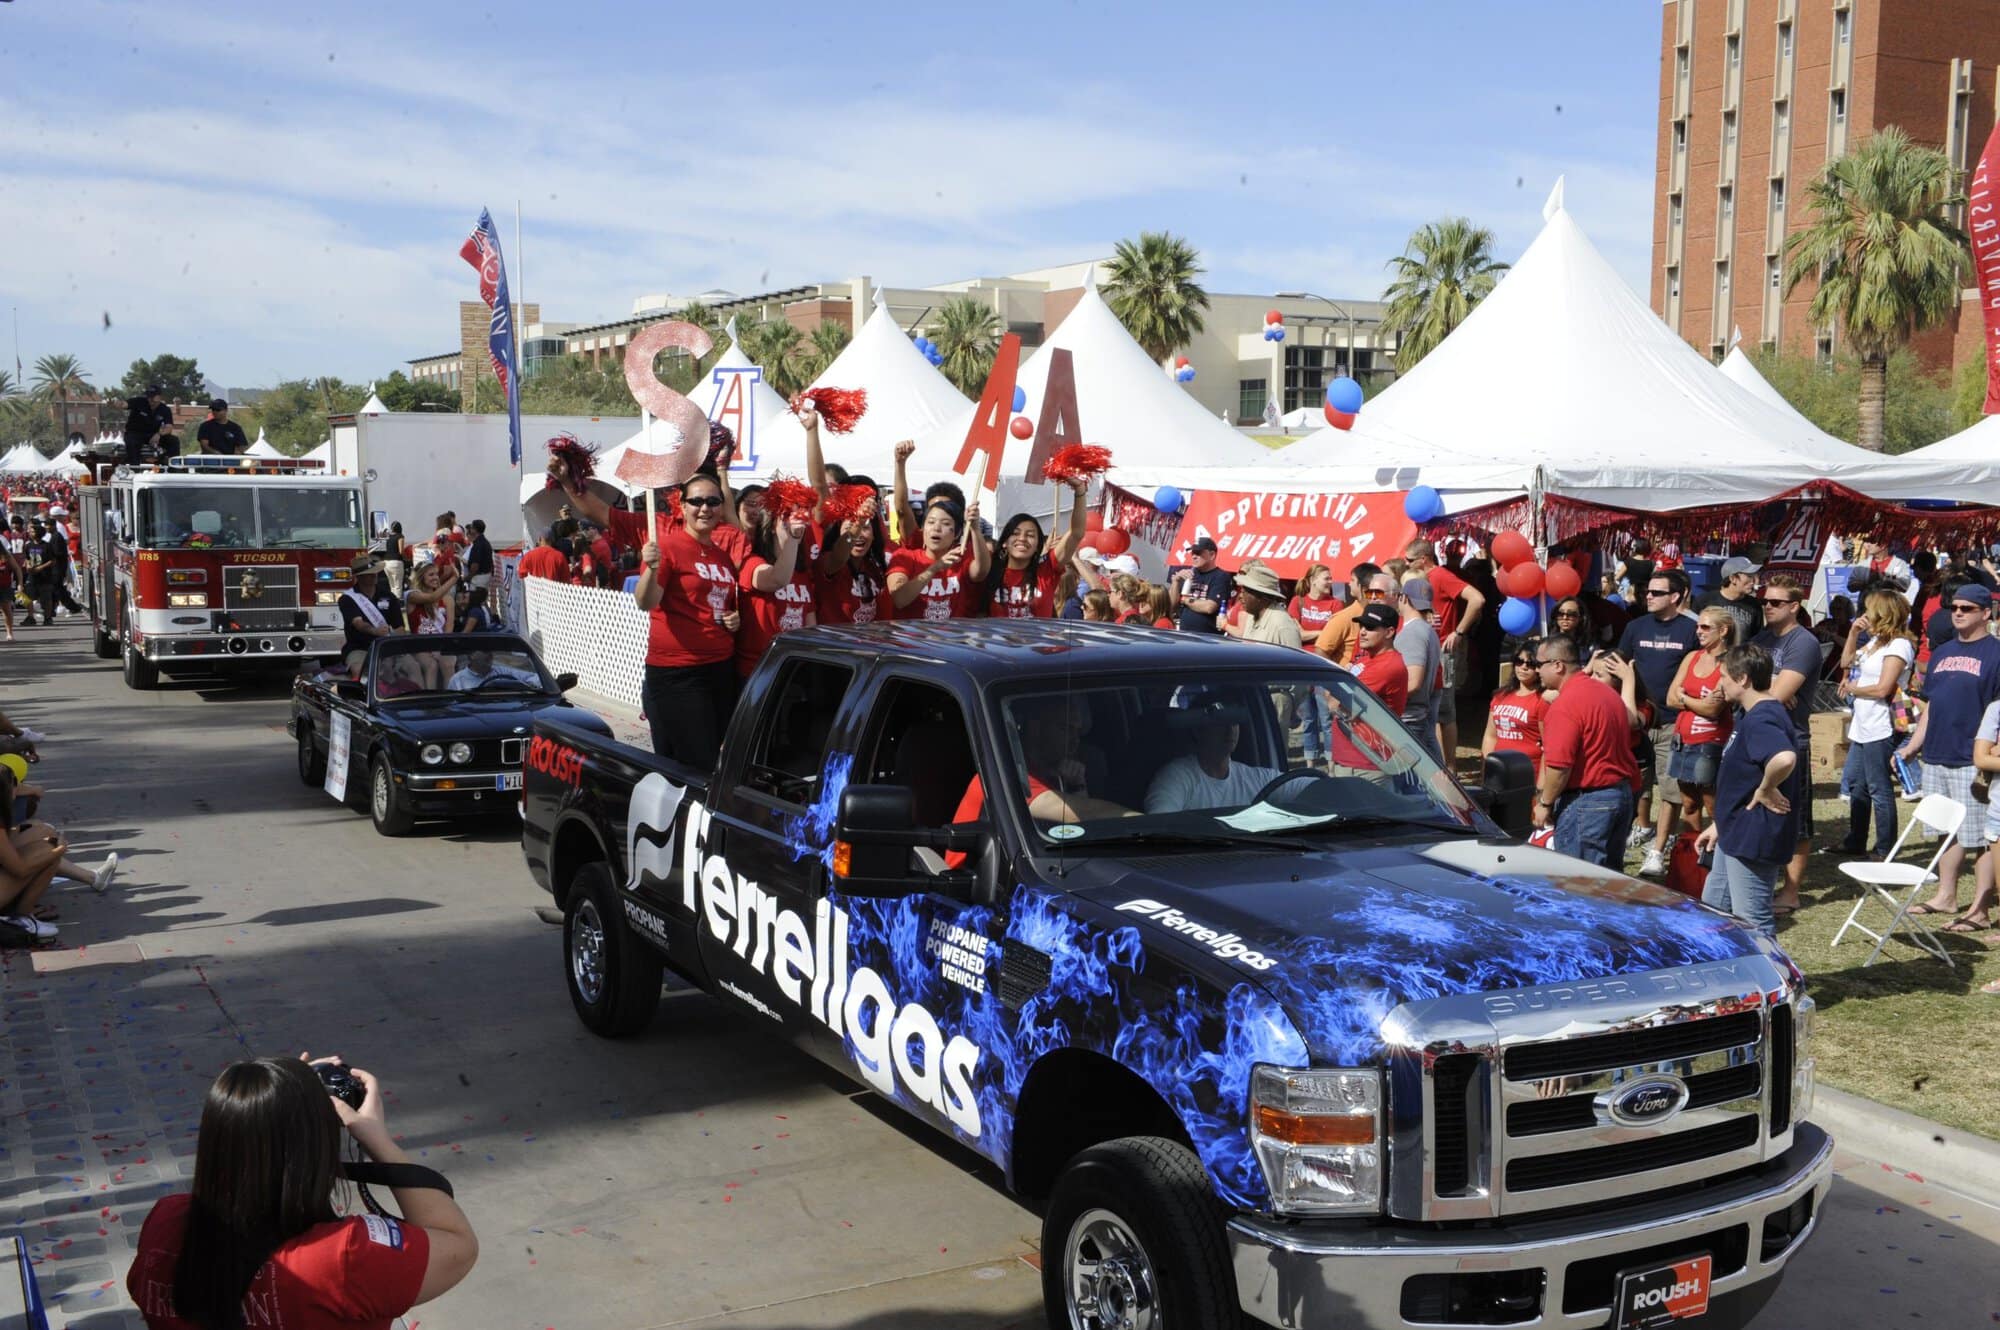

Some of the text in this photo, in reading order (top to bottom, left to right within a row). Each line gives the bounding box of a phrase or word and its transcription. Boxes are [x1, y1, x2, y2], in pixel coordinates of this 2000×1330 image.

[233, 553, 286, 563] TUCSON
[694, 562, 735, 584] SAA
[774, 584, 811, 603] SAA
[1932, 655, 1982, 677] ARIZONA
[529, 735, 586, 789] ROUSH
[623, 899, 668, 940] PROPANE
[930, 918, 989, 956] PROPANE
[925, 936, 986, 975] POWERED
[1149, 908, 1279, 971] Ferrellgas
[683, 800, 981, 1138] Ferrellgas
[941, 962, 985, 994] VEHICLE
[1484, 964, 1737, 1017] SUPER DUTY
[1633, 1088, 1670, 1113] Ford
[1633, 1278, 1700, 1310] ROUSH
